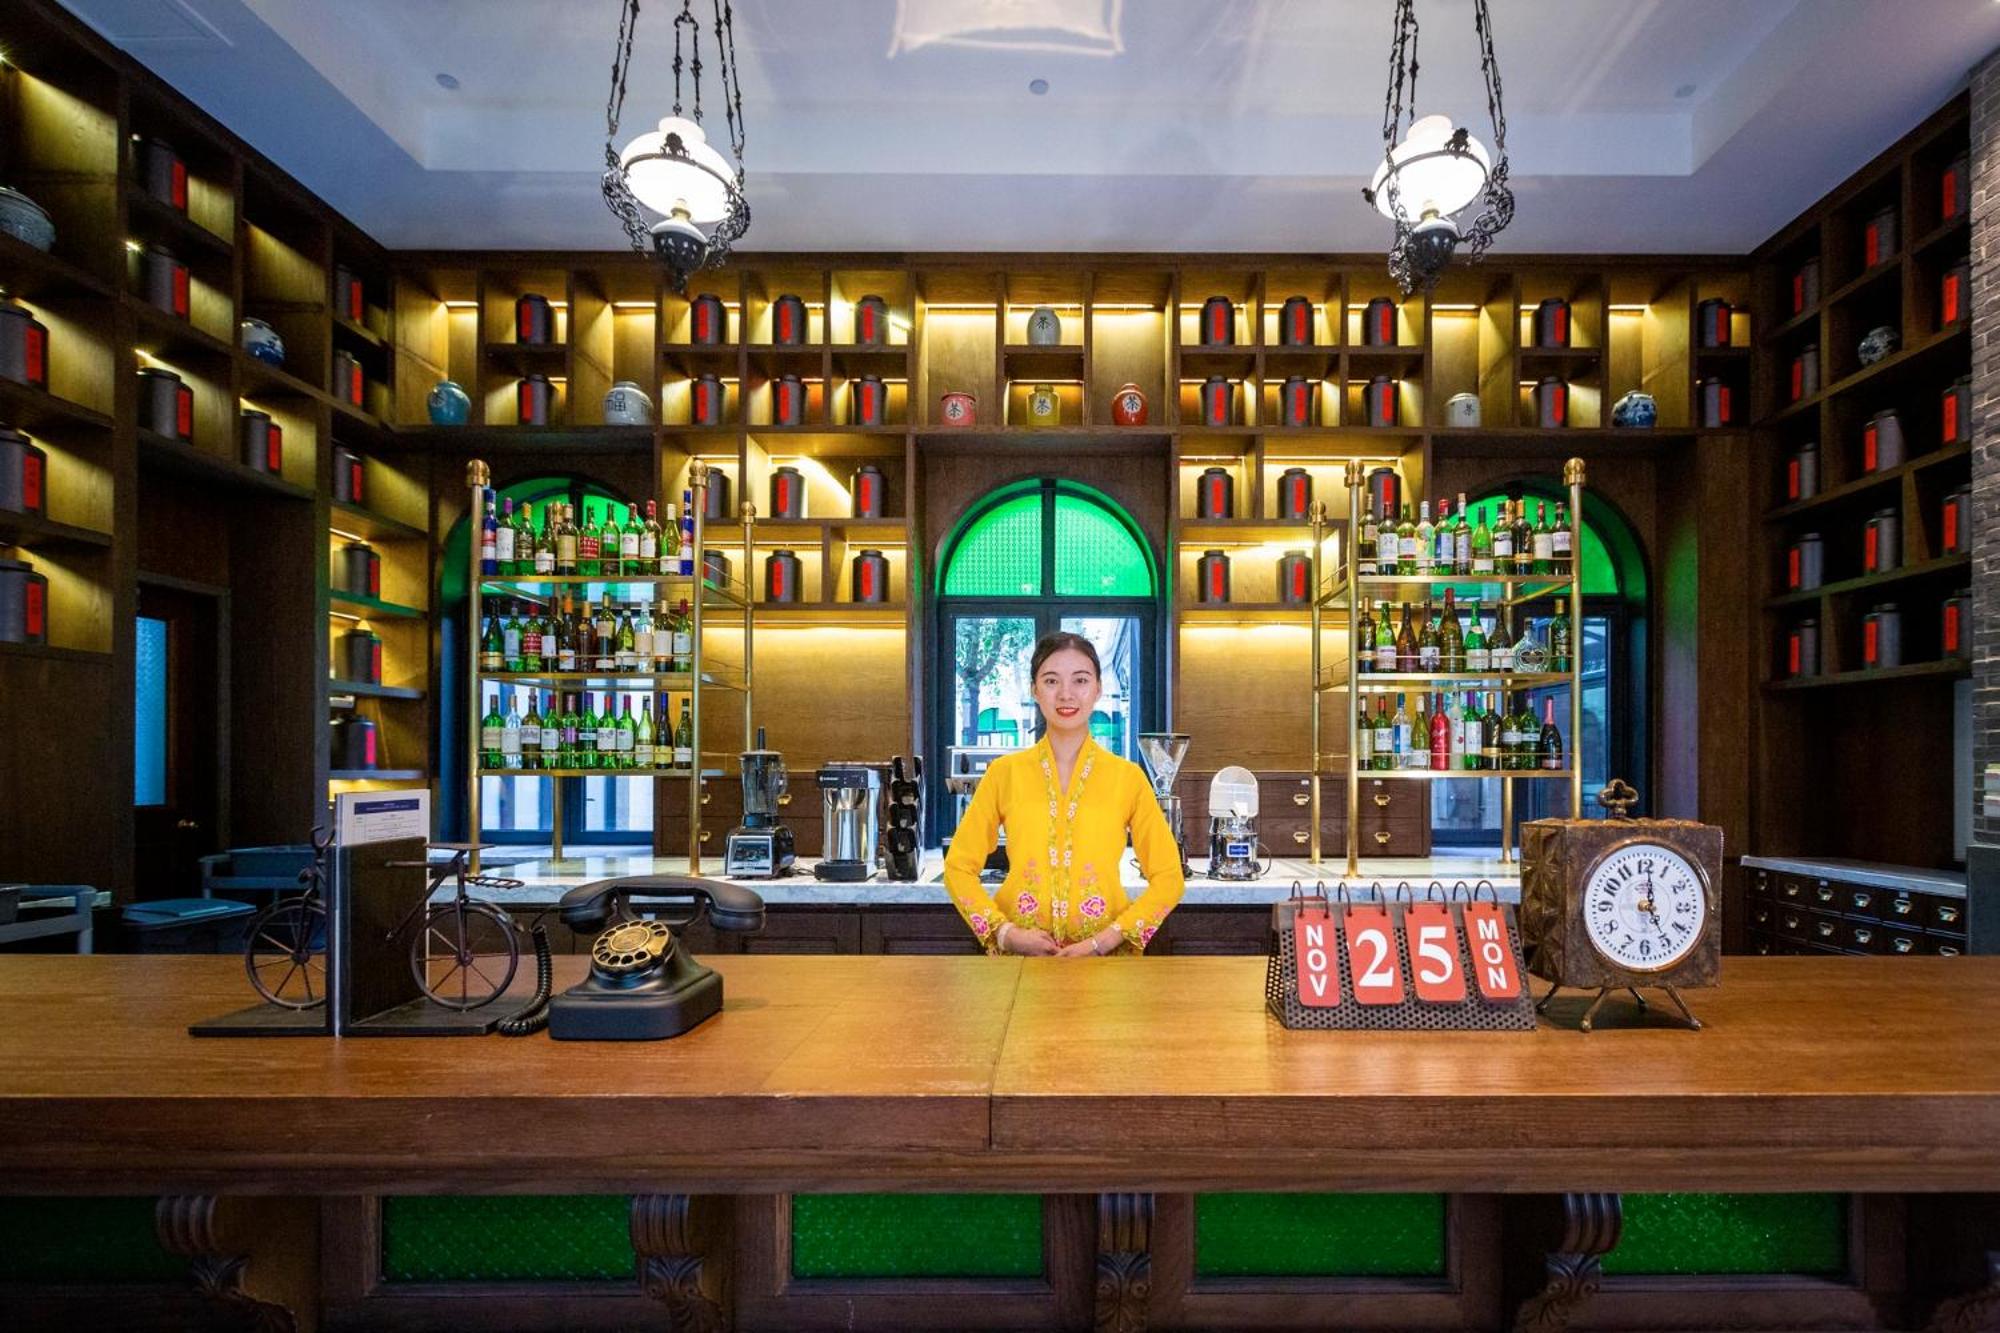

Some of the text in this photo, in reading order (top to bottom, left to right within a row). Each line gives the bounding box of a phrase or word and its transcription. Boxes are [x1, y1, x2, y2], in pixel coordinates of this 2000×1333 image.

[948, 402, 961, 418] 茶
[1035, 398, 1051, 415] 茶
[1124, 395, 1140, 411] 茶
[1617, 864, 1632, 881] 11
[1637, 859, 1653, 875] 12
[1659, 865, 1669, 878] 1
[1604, 877, 1621, 897] 10
[1672, 880, 1686, 894] 2
[1598, 900, 1614, 913] 9
[1675, 902, 1691, 914] 3
[1603, 919, 1619, 935] 8
[1671, 920, 1687, 933] 4
[1620, 934, 1634, 950] 7
[1639, 939, 1650, 956] 6
[1658, 932, 1671, 949] 5
[1306, 924, 1327, 997] NOV
[1477, 918, 1508, 990] MON
